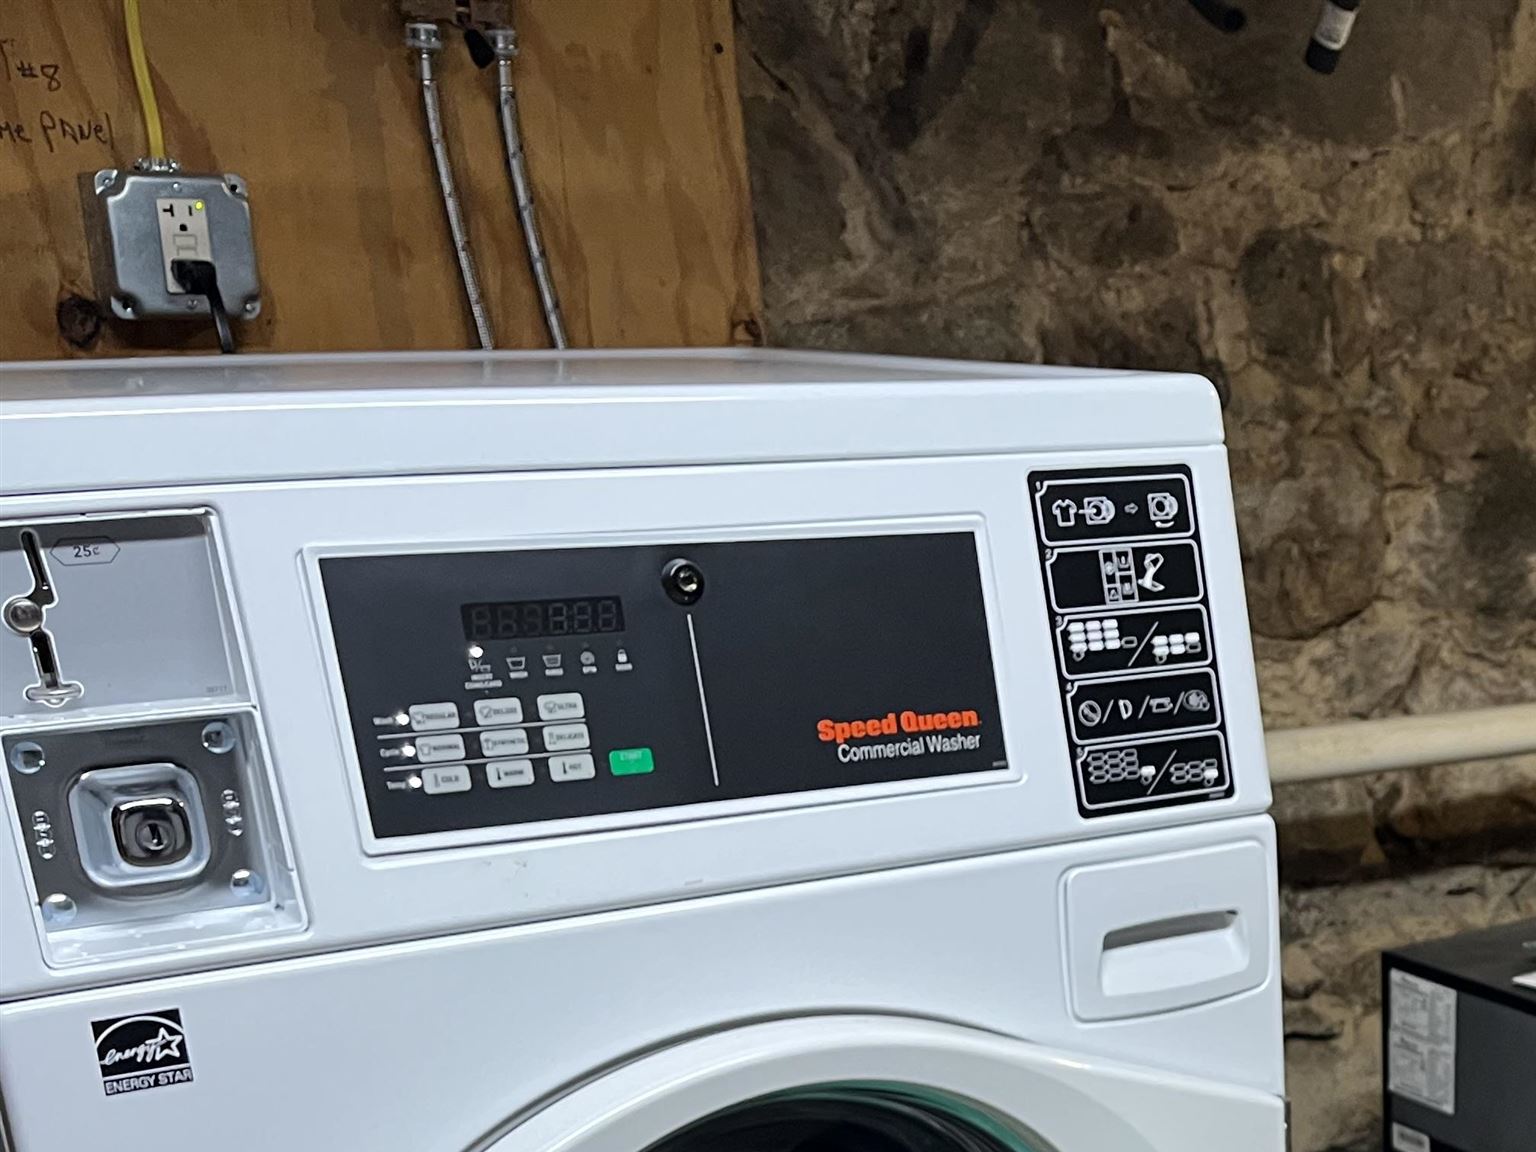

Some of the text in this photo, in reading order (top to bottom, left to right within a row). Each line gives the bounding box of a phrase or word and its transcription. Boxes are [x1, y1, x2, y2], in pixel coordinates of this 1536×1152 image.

[816, 709, 979, 744] Speed Queen
[837, 732, 981, 763] Commercial Washer
[105, 1069, 192, 1095] ENERGY STAR
